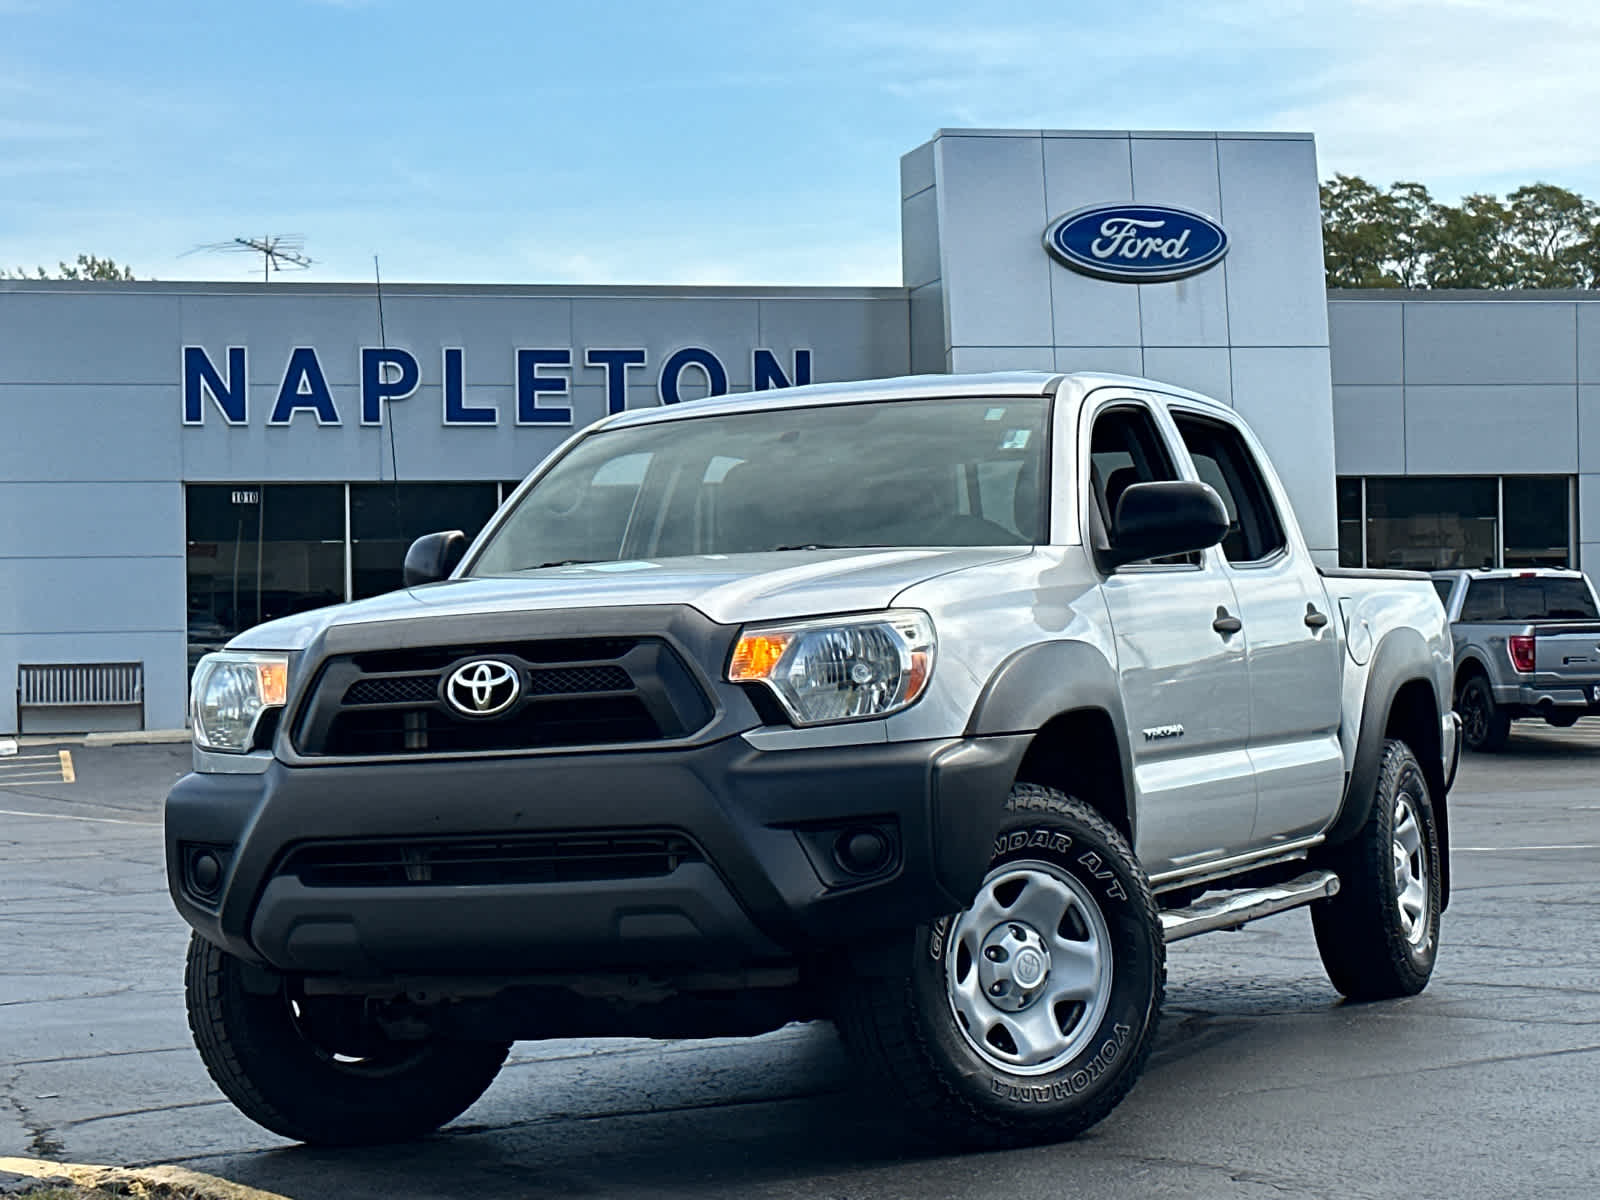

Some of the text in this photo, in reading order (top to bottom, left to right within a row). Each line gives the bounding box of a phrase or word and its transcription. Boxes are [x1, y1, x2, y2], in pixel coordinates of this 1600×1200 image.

[1091, 217, 1191, 259] Ford
[181, 345, 812, 426] NAPLETON
[233, 491, 258, 504] 1010
[1077, 851, 1128, 901] A/T
[992, 1023, 1130, 1103] YOKOHAMA
